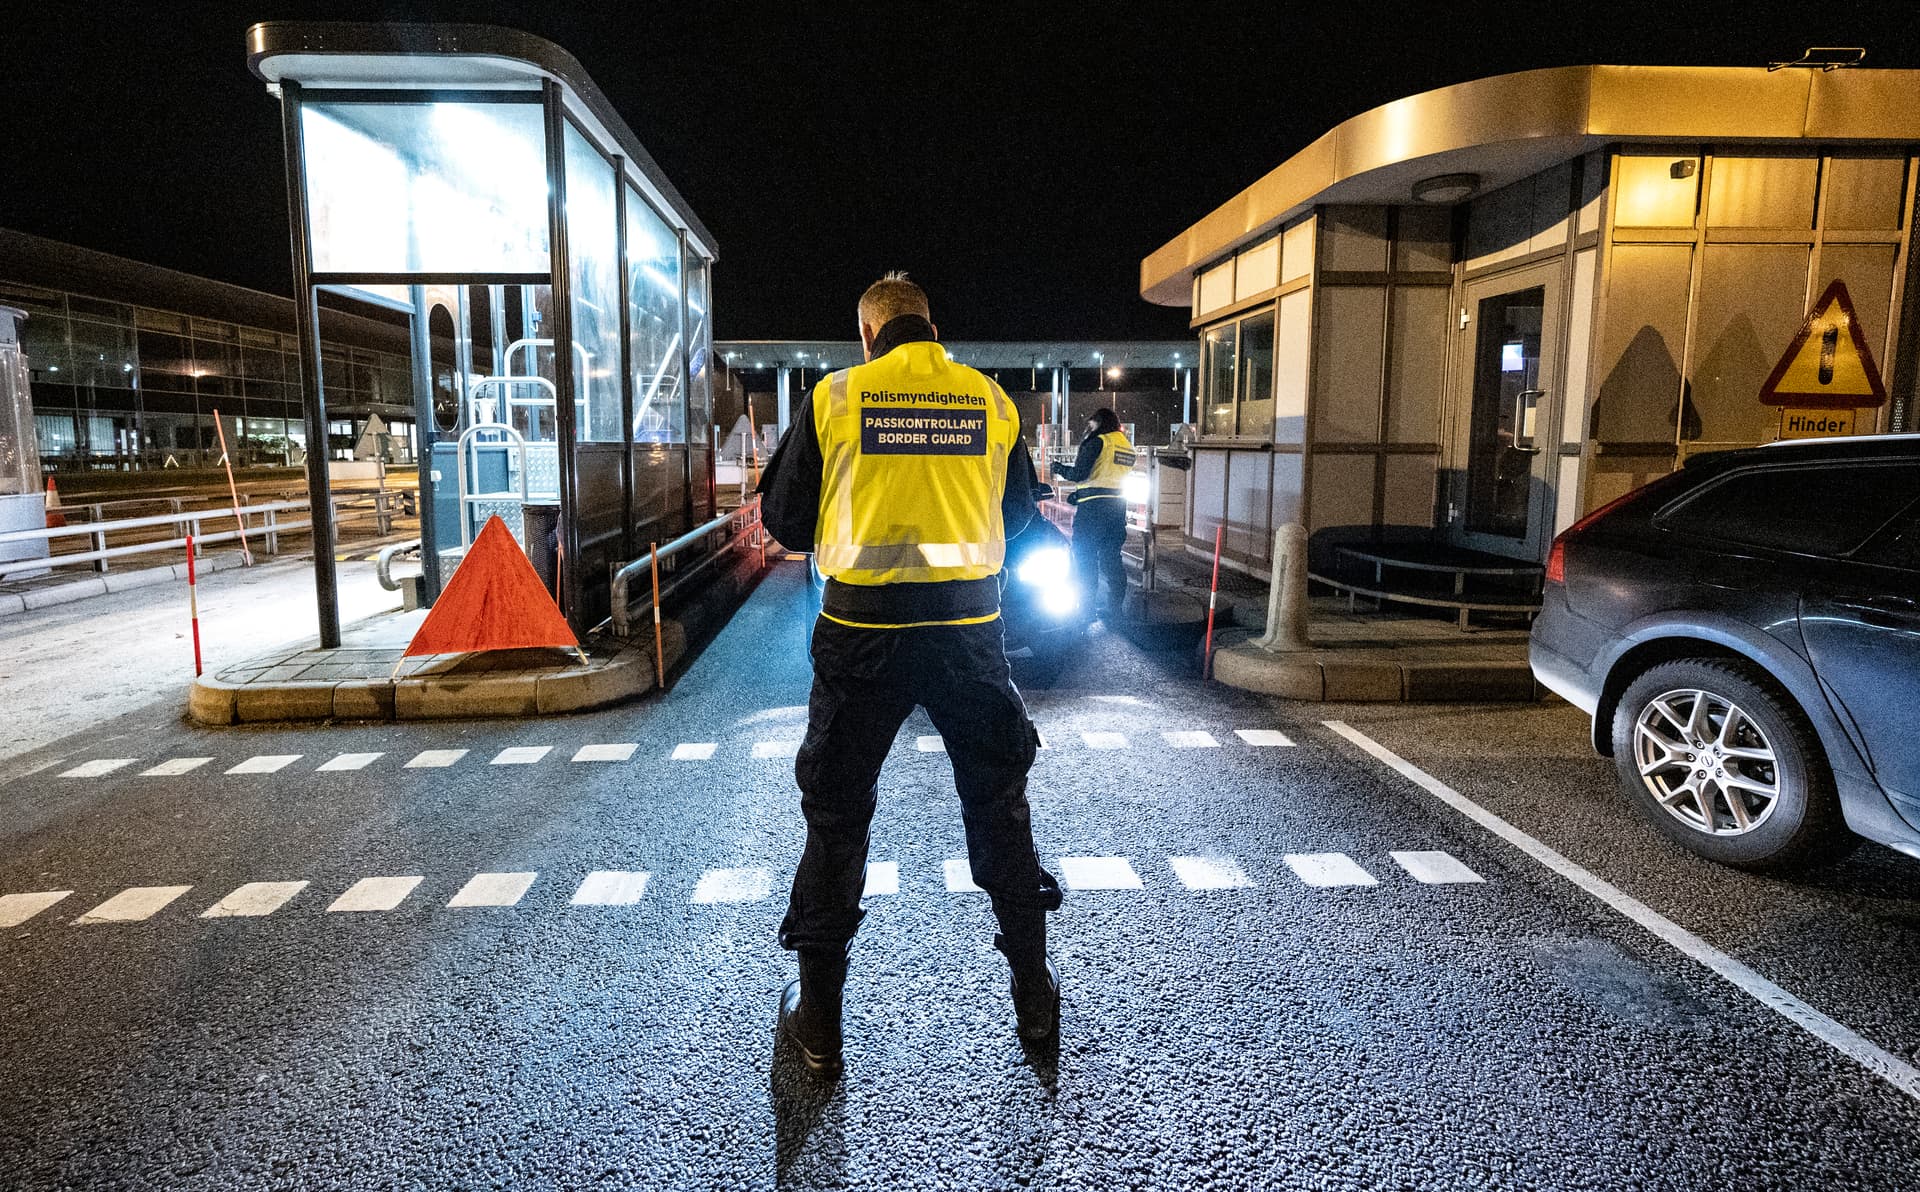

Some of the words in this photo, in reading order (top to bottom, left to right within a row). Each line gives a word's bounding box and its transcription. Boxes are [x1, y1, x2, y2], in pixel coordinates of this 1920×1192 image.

[861, 391, 986, 406] Polismyndigheten
[865, 418, 983, 430] PASSKONTROLLANT
[1789, 416, 1846, 432] Hinder
[878, 433, 928, 444] BORDER
[931, 433, 972, 445] GUARD
